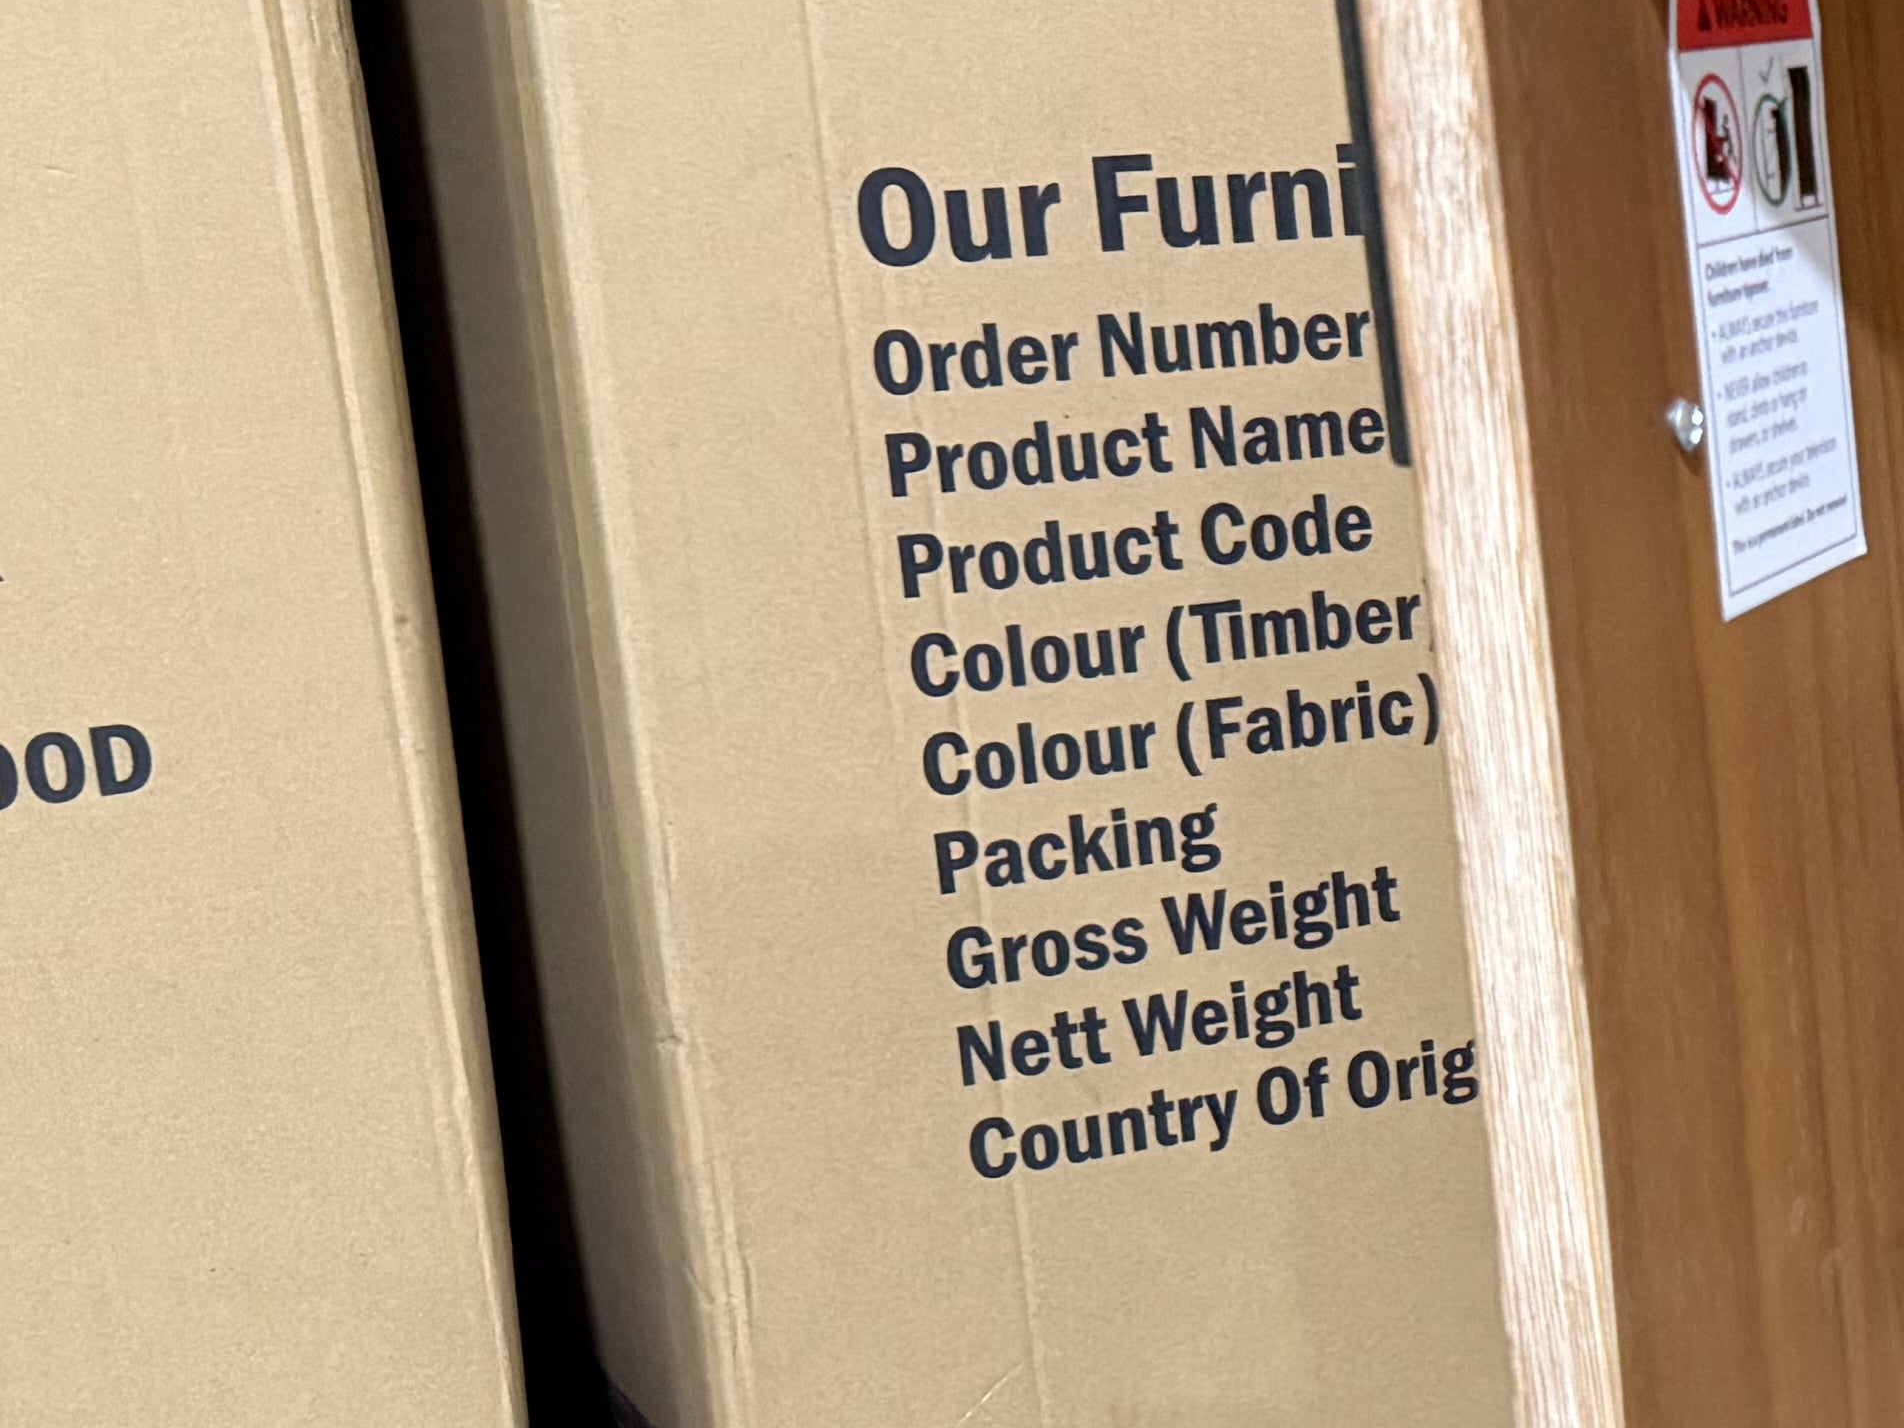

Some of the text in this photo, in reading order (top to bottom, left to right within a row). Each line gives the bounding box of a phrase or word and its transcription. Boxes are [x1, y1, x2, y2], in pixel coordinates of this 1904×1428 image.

[857, 143, 1365, 267] Our Furni
[873, 303, 1370, 395] Order Number
[884, 404, 1385, 497] Product Name
[897, 494, 1373, 598] Product Code
[910, 591, 1422, 696] Colour (Timber
[922, 673, 1440, 796] Colour (Fabric)
[933, 803, 1222, 895] Packing
[946, 866, 1401, 989] Gross Weight
[956, 964, 1363, 1086] Nett Weight
[969, 1038, 1480, 1179] Country Of Orig
